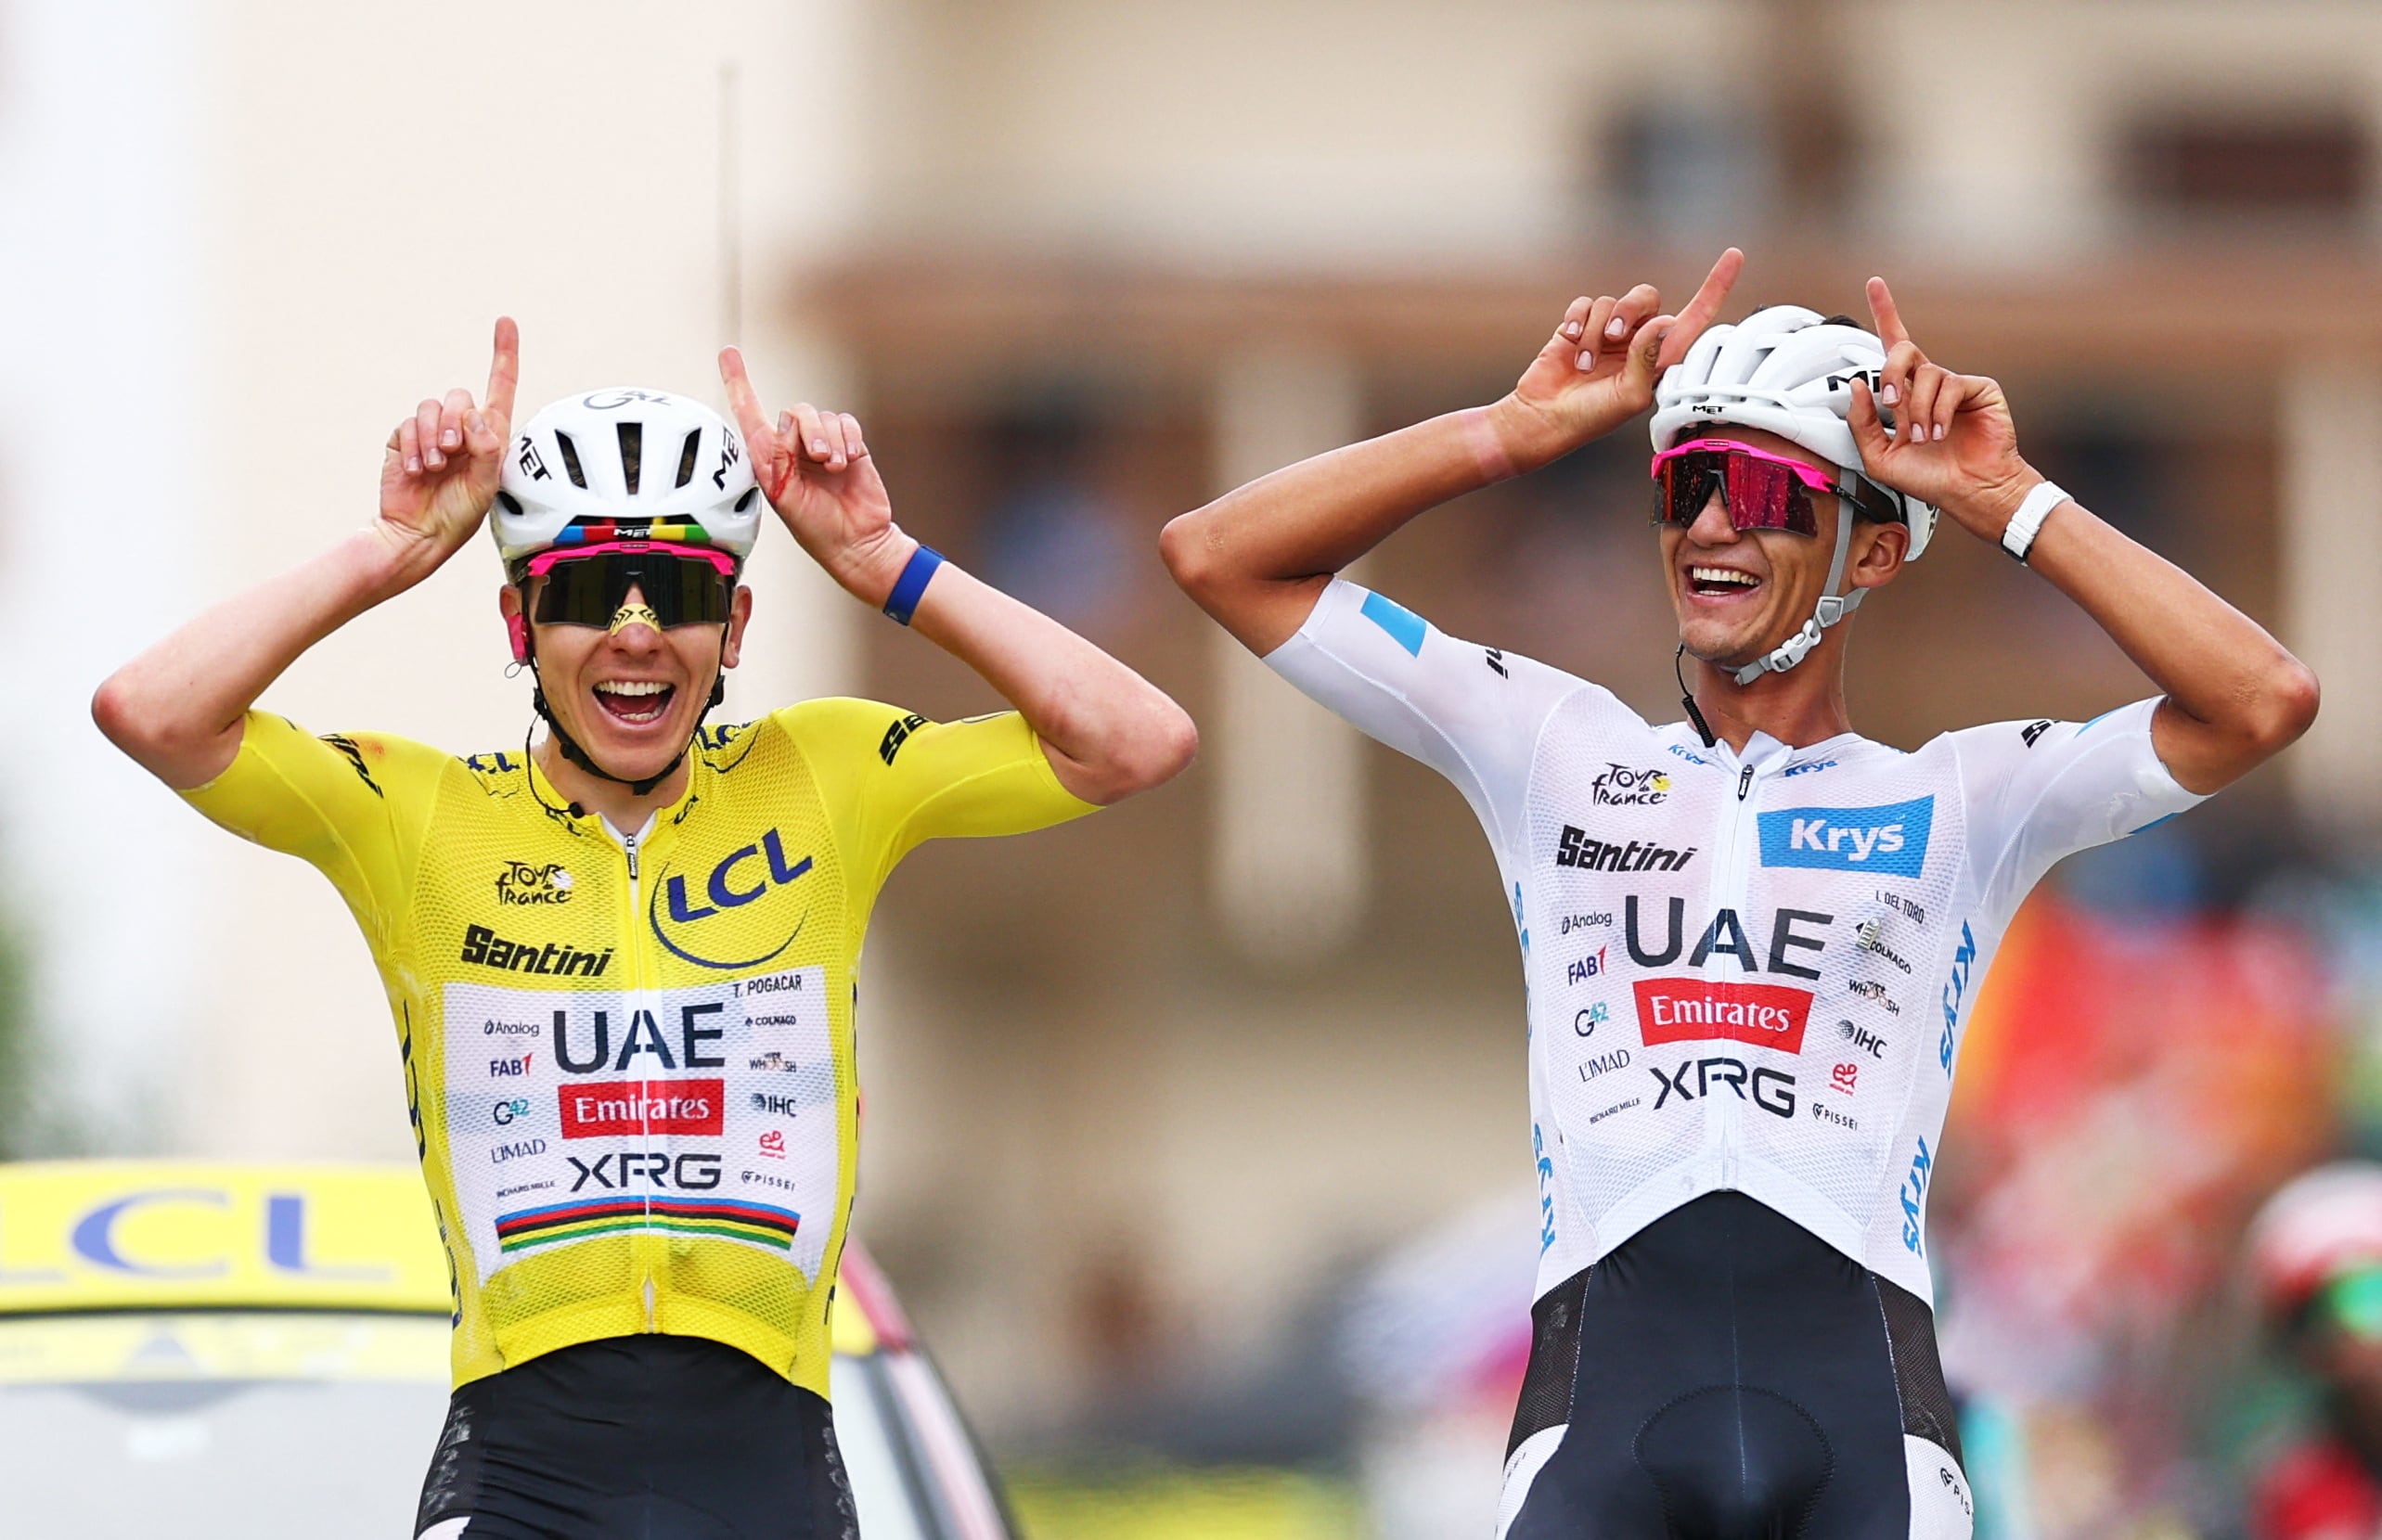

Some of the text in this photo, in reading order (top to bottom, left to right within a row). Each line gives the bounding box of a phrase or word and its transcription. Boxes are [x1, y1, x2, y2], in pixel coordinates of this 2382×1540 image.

[1692, 404, 1727, 415] MET
[1784, 760, 1838, 777] Krys
[1556, 824, 1698, 873] Santini
[1790, 817, 1905, 863] Krys
[665, 827, 813, 924] LCL
[1571, 911, 1613, 930] Analog
[1884, 892, 1900, 911] DEL
[1903, 898, 1925, 925] TORO
[460, 923, 615, 977] Santini
[1624, 894, 1835, 982] UAE
[1869, 940, 1912, 975] COLNAGO
[747, 974, 803, 996] POGACAR
[1939, 918, 1976, 1082] Krys
[495, 1021, 540, 1037] Analog
[754, 1015, 796, 1026] COLNAGO
[1649, 994, 1791, 1033] Emirates
[552, 1002, 727, 1074] UAE
[1854, 1026, 1887, 1059] IHC
[1649, 1057, 1796, 1120] XRG
[574, 1094, 710, 1124] Emirates
[767, 1095, 797, 1118] IHC
[1590, 1097, 1641, 1125] RICHARD MILLE
[1823, 1109, 1858, 1131] PISSEI
[566, 1152, 722, 1193] XRG
[753, 1175, 796, 1192] PISSEI
[1899, 1135, 1931, 1260] Krys
